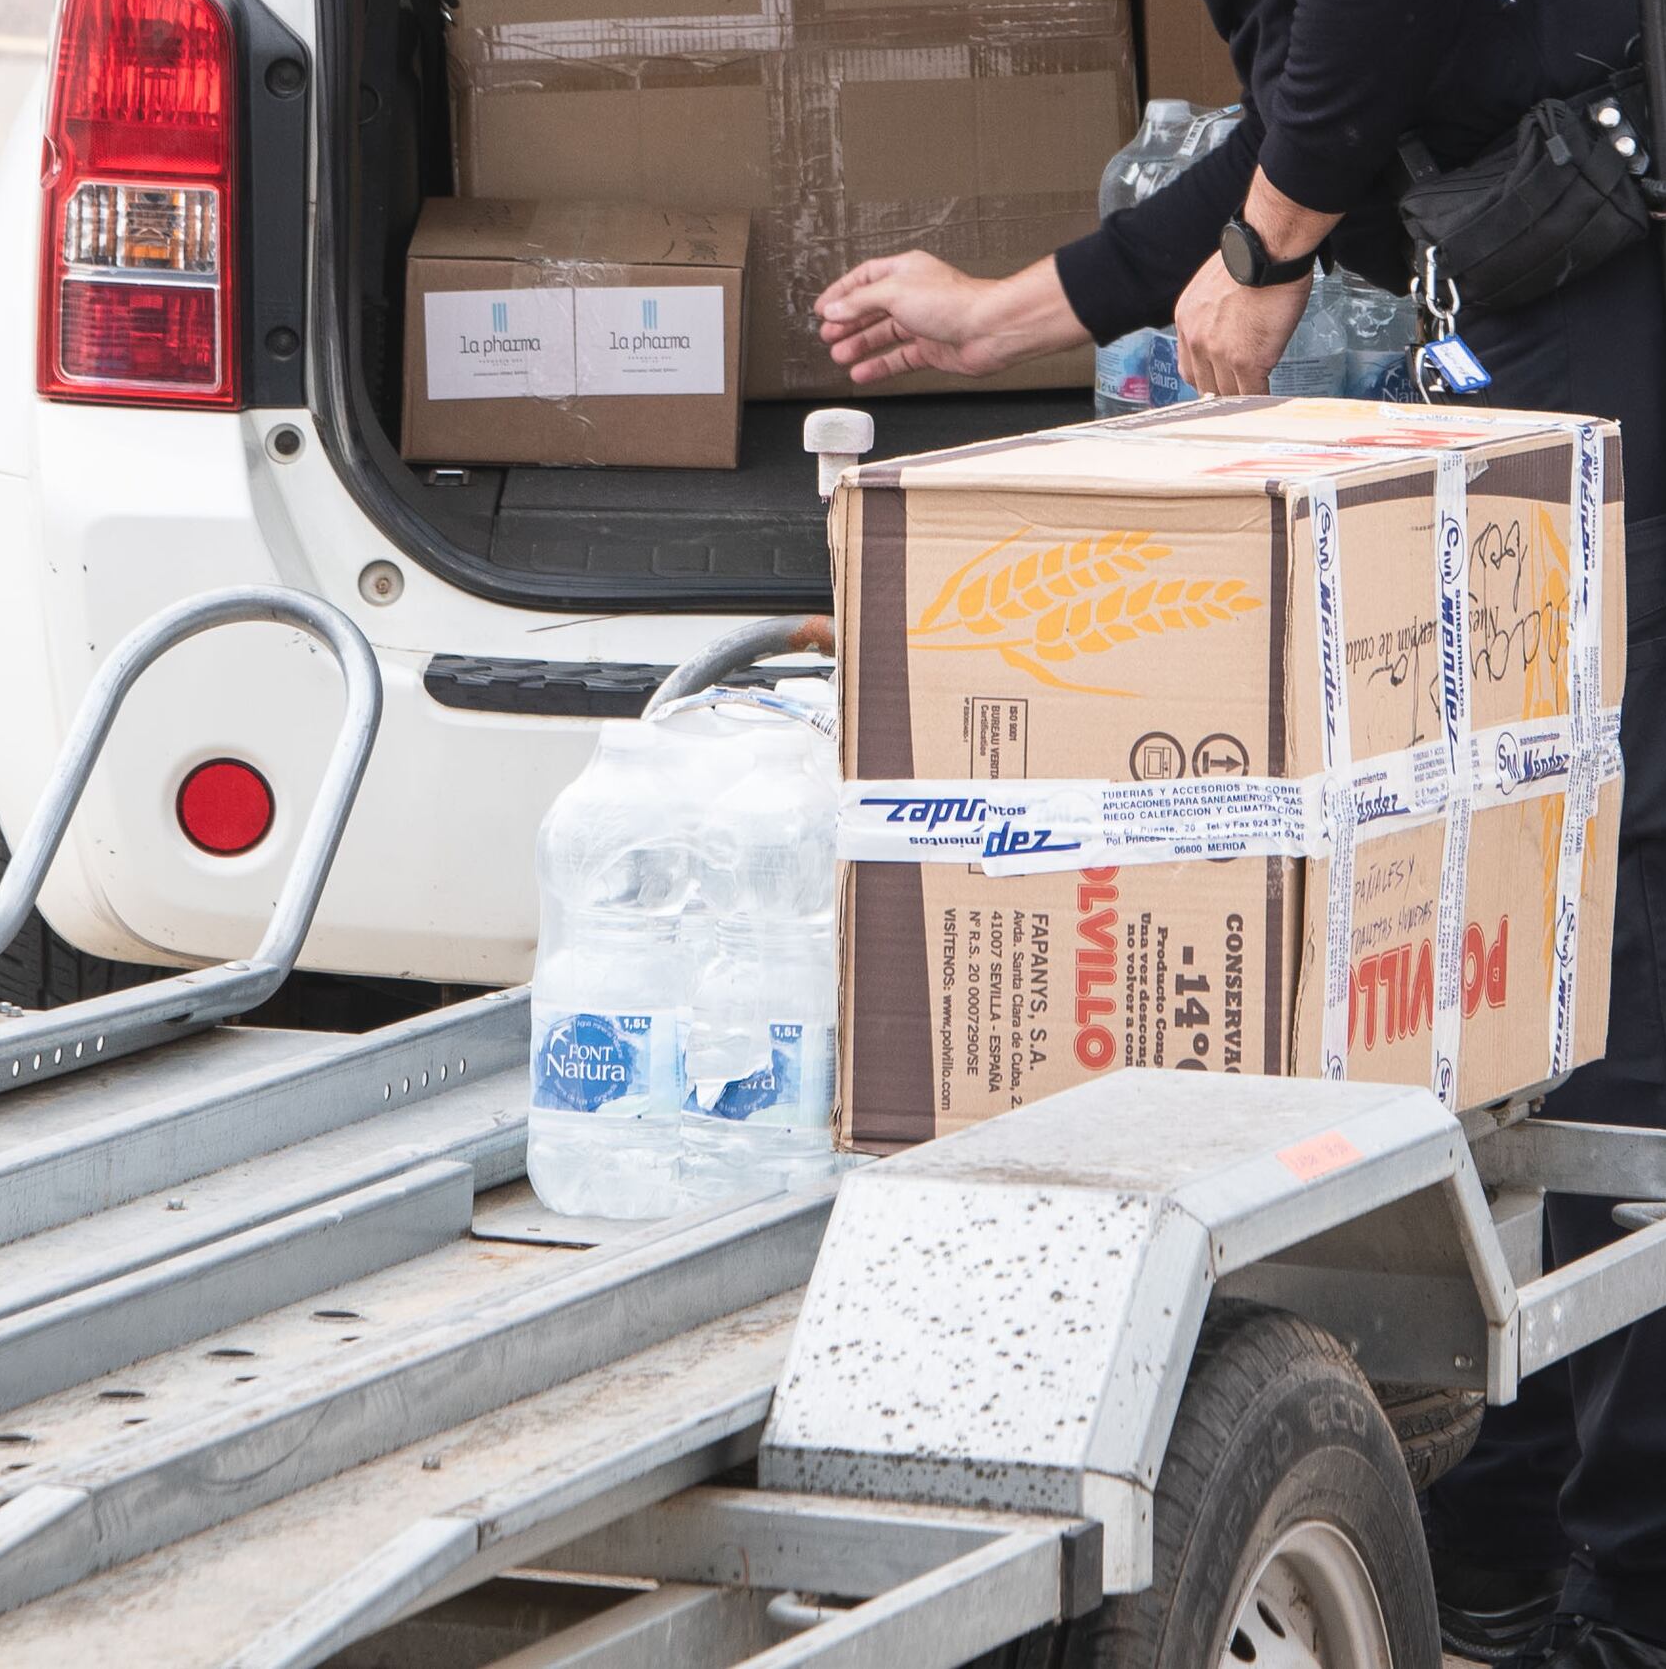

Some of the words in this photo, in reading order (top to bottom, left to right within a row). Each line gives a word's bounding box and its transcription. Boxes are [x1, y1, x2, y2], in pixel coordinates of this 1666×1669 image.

[459, 335, 480, 354] la
[483, 335, 541, 358] pharma
[609, 331, 630, 350] la
[632, 331, 691, 355] pharma
[1454, 588, 1466, 719] saneamientos
[990, 704, 1001, 745] BUREAU
[990, 747, 1000, 780] VERITA
[1102, 788, 1154, 800] TUBERIAS
[1172, 783, 1241, 796] ACCESORIOS
[1264, 785, 1301, 795] COBRE
[1102, 798, 1171, 810] APLICACIONES
[1173, 798, 1199, 808] PARA
[1201, 793, 1273, 805] SANEAMIENTOS
[1354, 790, 1410, 825] éndez
[1103, 812, 1135, 822] RIEGO
[1139, 807, 1211, 820] CALEFACCION
[1233, 820, 1249, 829] Fax
[1252, 819, 1269, 828] 924
[1174, 844, 1202, 855] 06800
[1207, 841, 1247, 852] MERIDA
[968, 930, 980, 960] R.S.
[991, 911, 1003, 958] 41007
[1012, 909, 1025, 948] Avda.
[1126, 924, 1135, 948] no
[1140, 912, 1151, 949] Una
[942, 908, 956, 992] VISÍTENOS:
[1026, 913, 1049, 1021] FAPANYS,
[968, 964, 980, 984] 20
[1012, 951, 1025, 990] Santa
[1125, 952, 1137, 1013] volver
[1139, 952, 1149, 986] vez
[1156, 926, 1168, 1014] Producto
[989, 961, 1002, 1023] SEVILLA
[1223, 913, 1244, 1074] CONSERVA
[623, 1018, 649, 1030] 1,5L
[1011, 994, 1024, 1028] Clara
[1125, 1016, 1134, 1028] a
[1136, 989, 1149, 1067] descong
[774, 1026, 800, 1038] 1,5L
[1010, 1032, 1023, 1048] de
[1028, 1028, 1048, 1071] S.A.
[1124, 1031, 1134, 1067] con
[1153, 1016, 1167, 1068] Cong
[545, 1052, 626, 1082] Natura
[569, 1043, 613, 1062] FONT
[938, 994, 953, 1112] www.polvillo.com
[988, 1034, 1001, 1094] ESPAÑA
[1009, 1051, 1023, 1091] Cuba,
